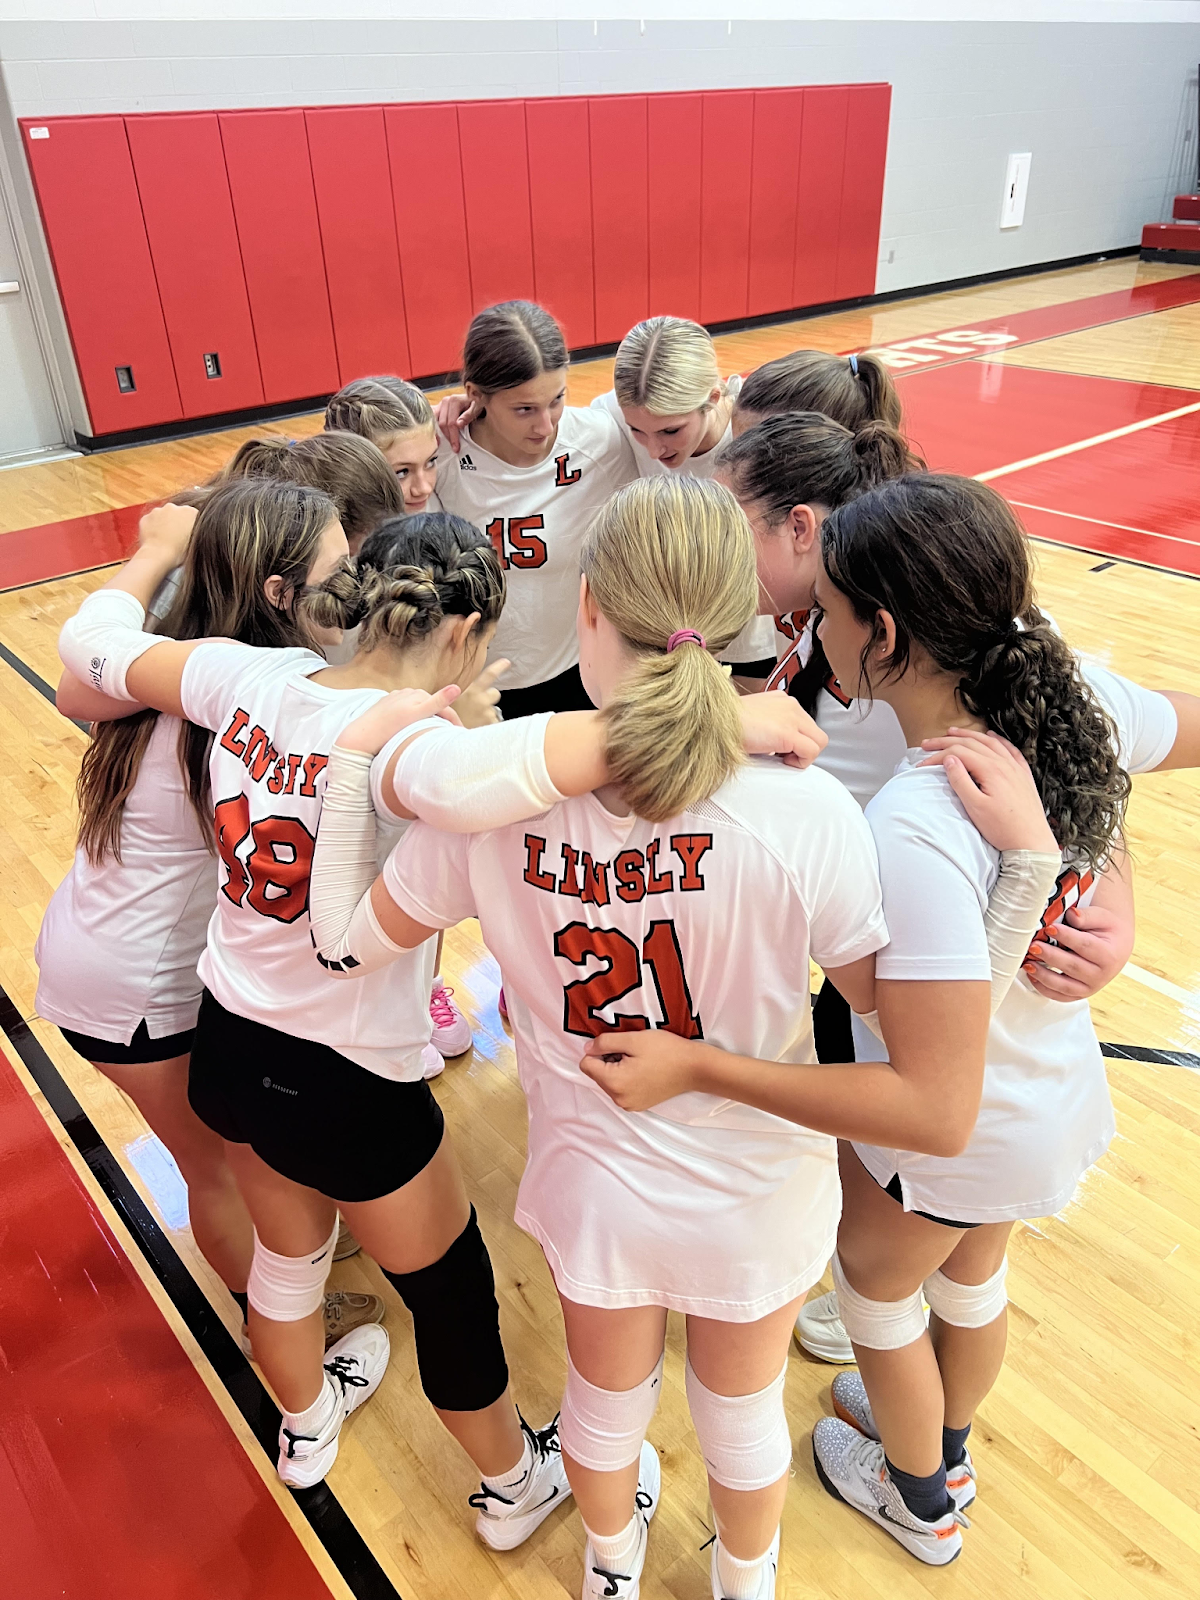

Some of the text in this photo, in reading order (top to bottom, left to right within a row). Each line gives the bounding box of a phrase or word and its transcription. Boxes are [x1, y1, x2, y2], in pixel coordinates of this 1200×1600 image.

[856, 330, 1020, 368] ATS
[555, 453, 582, 487] L
[486, 514, 548, 570] 15
[524, 833, 713, 907] LINSLY
[554, 919, 704, 1040] 21
